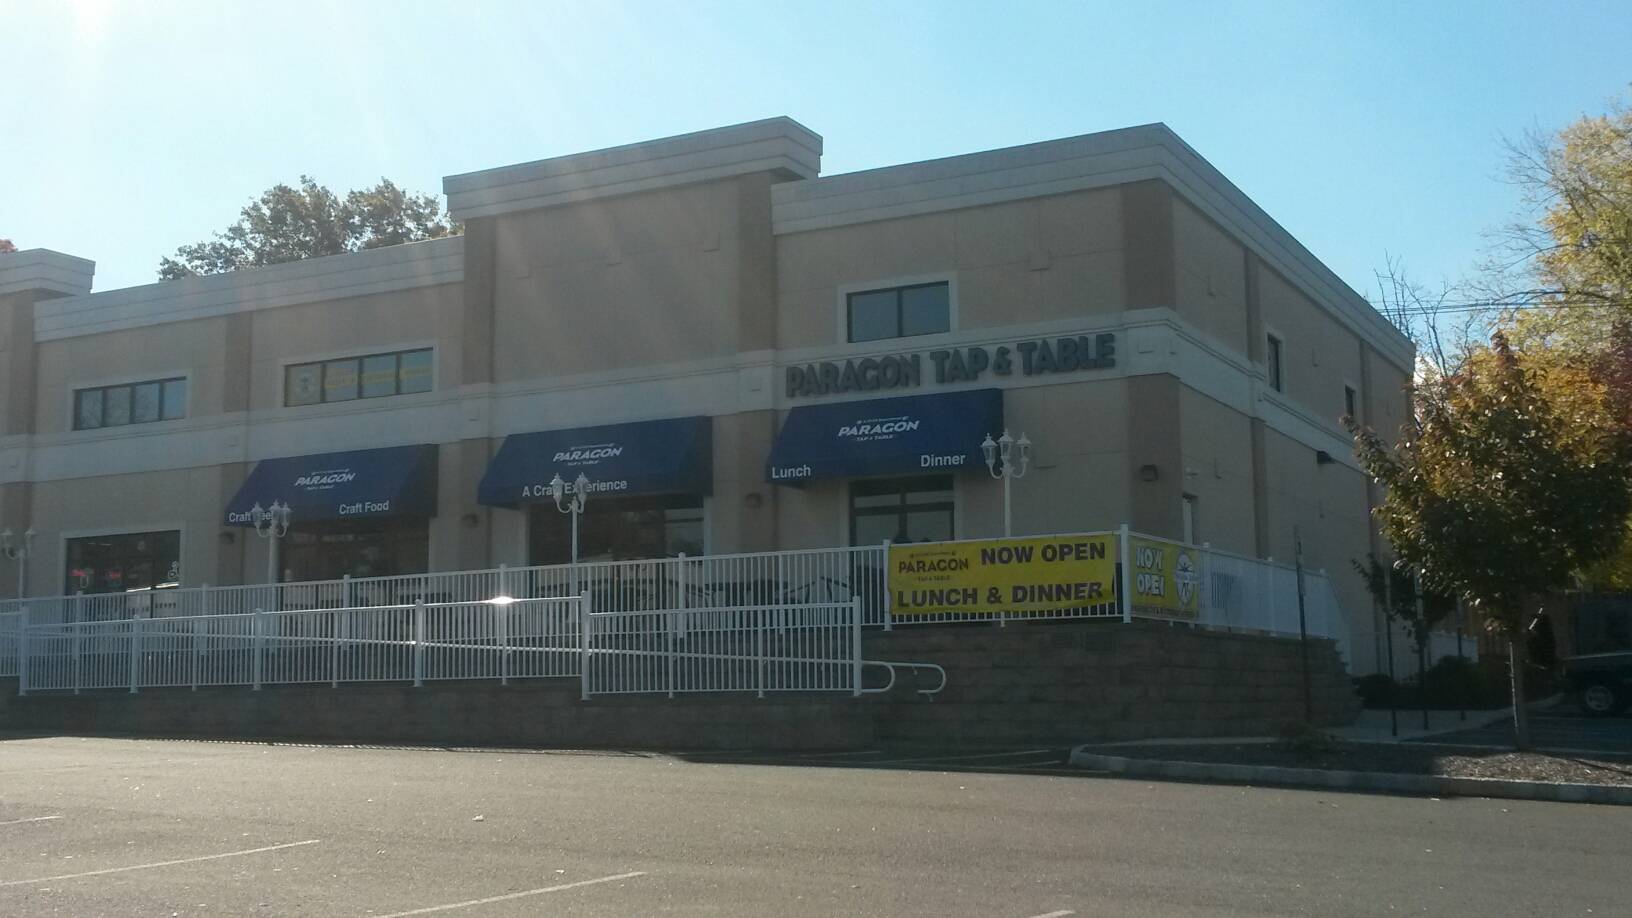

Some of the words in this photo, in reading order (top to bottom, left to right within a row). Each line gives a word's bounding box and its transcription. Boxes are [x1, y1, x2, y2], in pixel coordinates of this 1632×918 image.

[786, 353, 921, 398] PARAGON
[930, 347, 989, 382] TAP
[993, 346, 1012, 375] &
[1017, 333, 1116, 375] TABLE
[838, 420, 920, 437] PARAGON
[552, 447, 623, 462] PARAGON
[920, 453, 967, 468] Dinner
[294, 473, 356, 486] PARAGON
[771, 464, 812, 480] Lunch
[522, 486, 531, 497] A
[533, 482, 561, 496] Cra
[564, 480, 628, 494] Exerience
[339, 503, 362, 515] Craft
[364, 500, 390, 512] Food
[981, 547, 1033, 566] NOW
[1041, 543, 1106, 561] OPEN
[1136, 547, 1163, 570] NOW
[899, 558, 969, 573] PARAGON
[1136, 573, 1165, 597] OPEN
[897, 587, 978, 607] LUNCH
[986, 586, 1003, 604] &
[1011, 582, 1104, 603] DINNER
